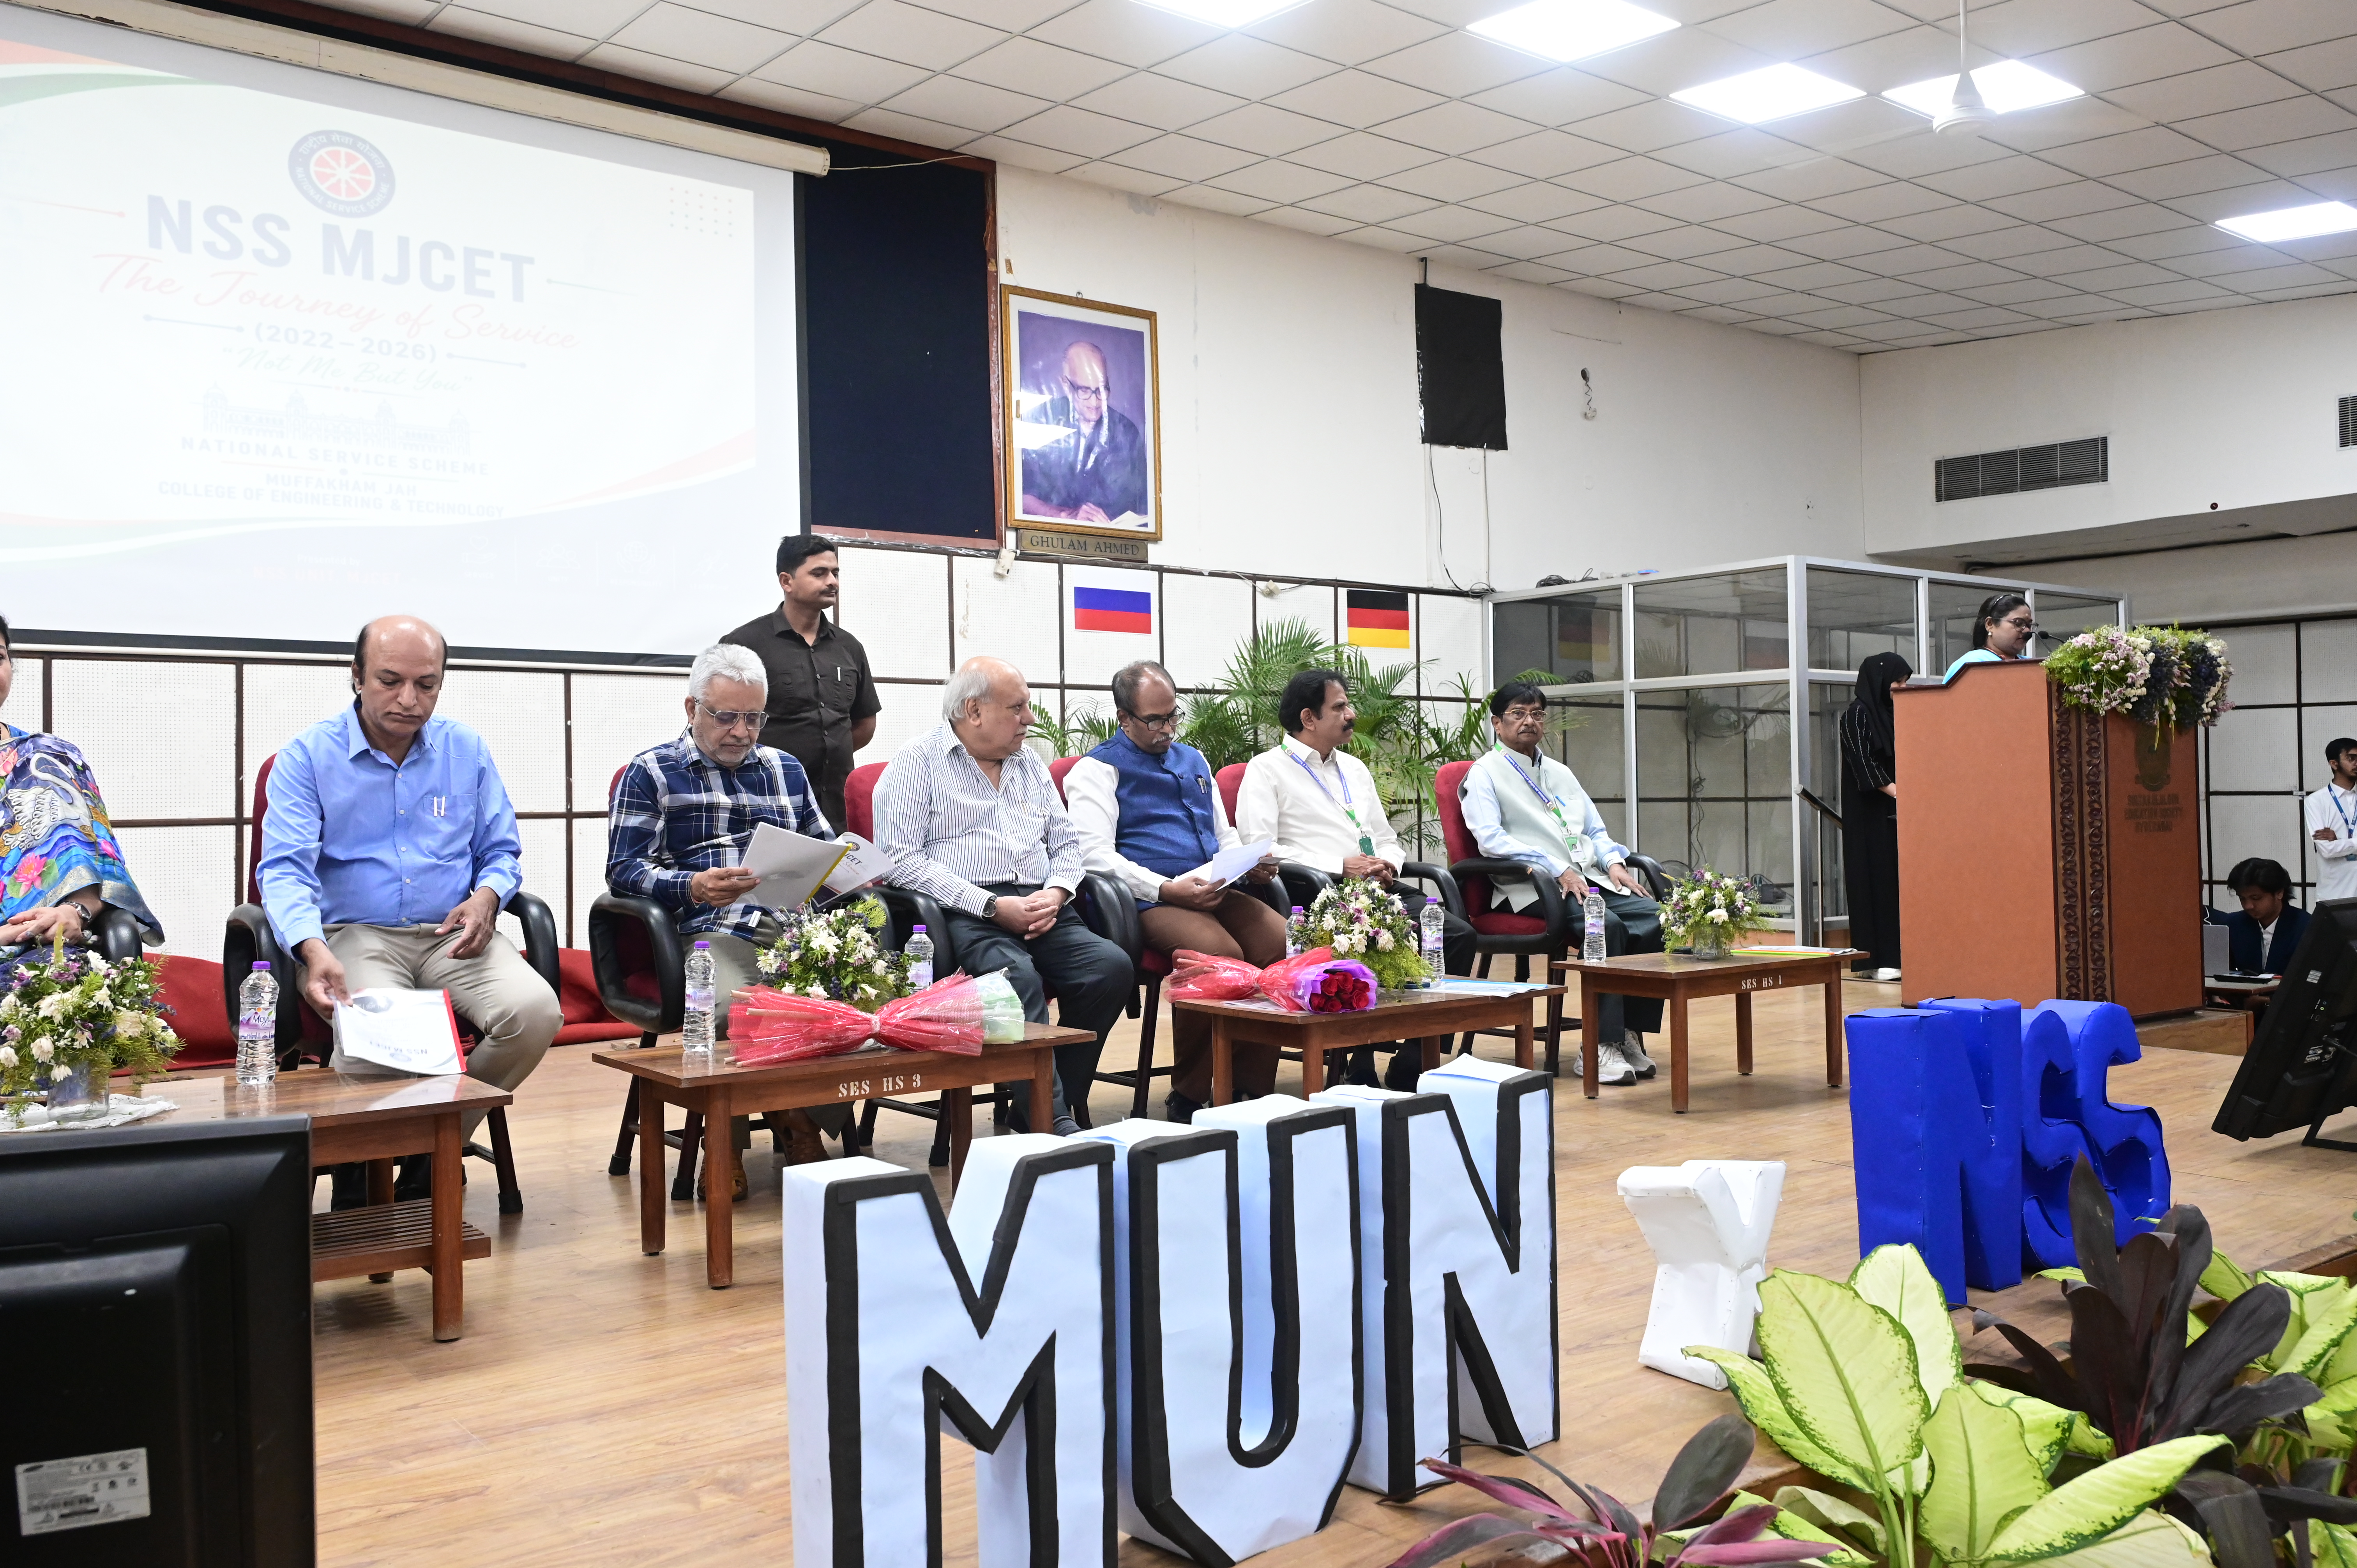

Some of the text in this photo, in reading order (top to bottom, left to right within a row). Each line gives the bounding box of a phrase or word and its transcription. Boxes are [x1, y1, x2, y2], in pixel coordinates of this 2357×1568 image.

[329, 132, 353, 145] सेवा
[295, 167, 389, 213] NATIONAL SERVICE SCHEME
[148, 194, 535, 303] NSS MJCET
[92, 254, 581, 349] The Journey of Service
[297, 355, 346, 380] Me
[353, 361, 409, 385] But
[181, 436, 489, 476] NATIONAL SERVICE SCHEME
[158, 480, 504, 518] COLLEGE OF ENGINEERING & TECHNOLOGY
[266, 473, 417, 497] MUFFAKHAM JAH
[1030, 535, 1139, 555] GHULAM AHMED
[844, 853, 862, 865] JCET
[1741, 978, 1757, 990] SES
[1762, 976, 1773, 988] HS
[838, 1074, 921, 1098] SES HS 3
[783, 1054, 1559, 1568] MUN
